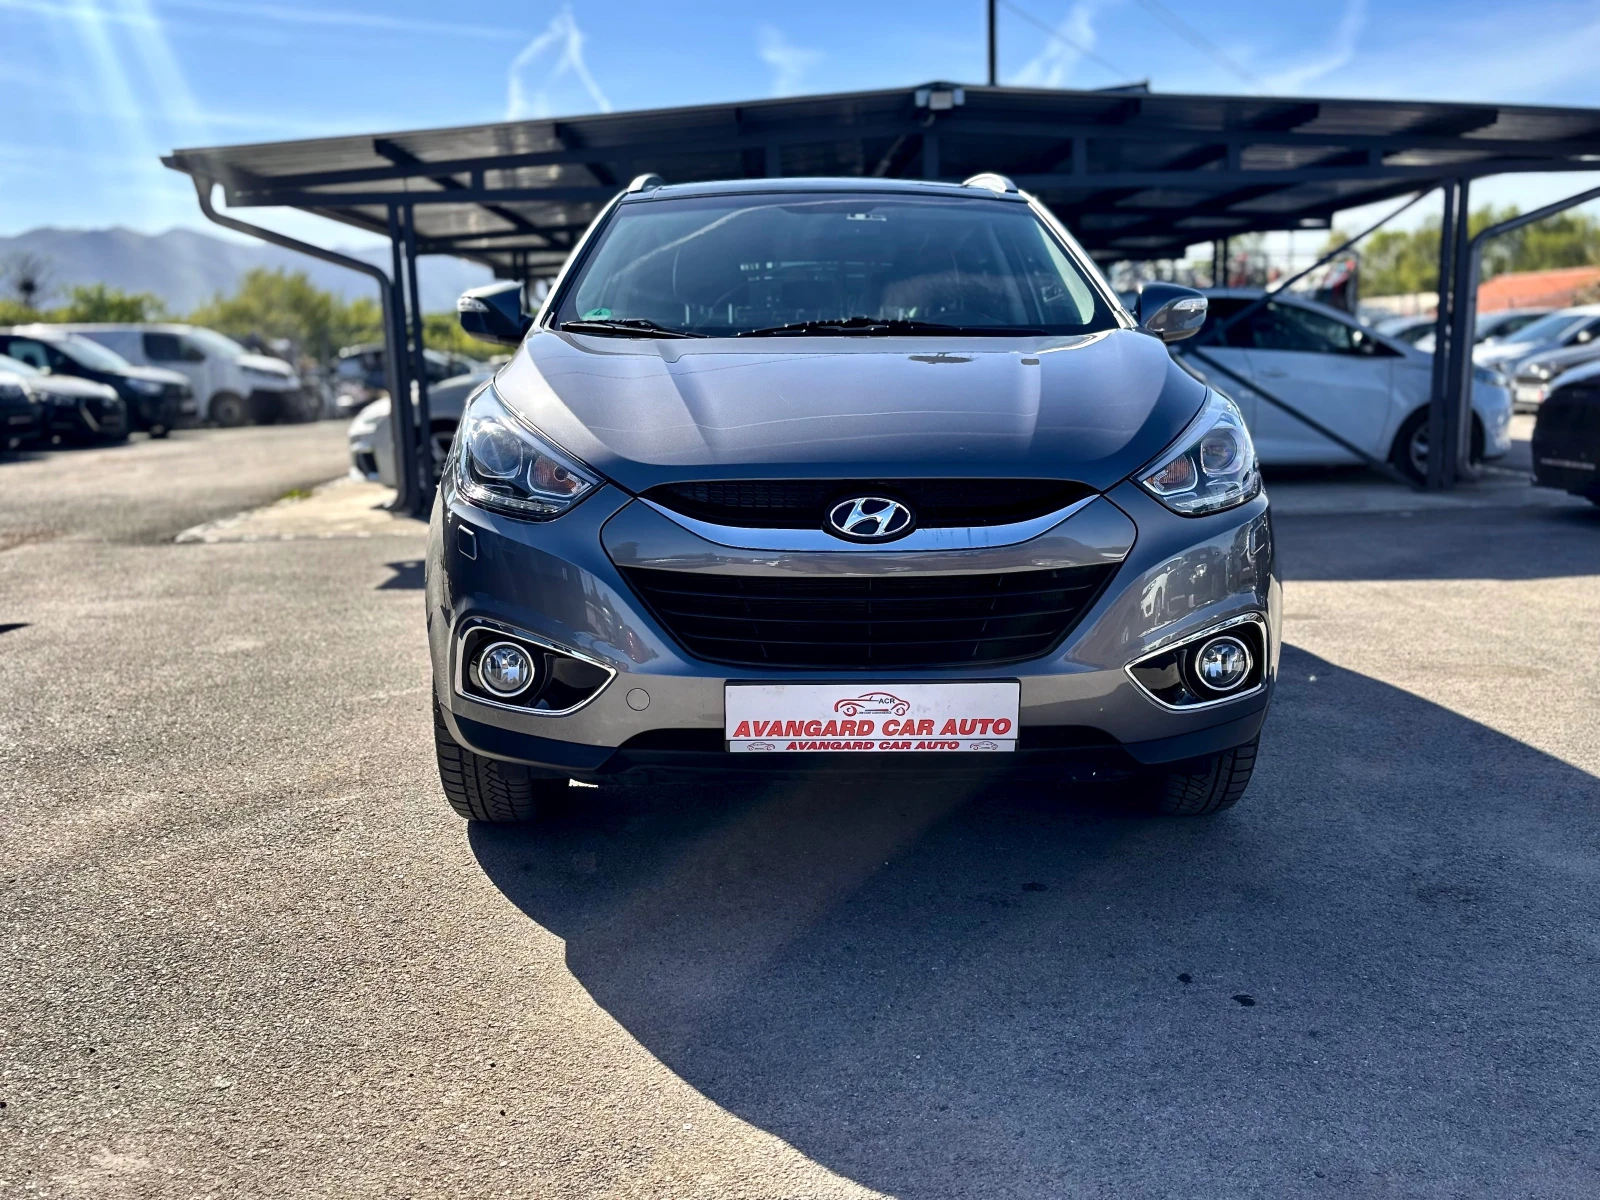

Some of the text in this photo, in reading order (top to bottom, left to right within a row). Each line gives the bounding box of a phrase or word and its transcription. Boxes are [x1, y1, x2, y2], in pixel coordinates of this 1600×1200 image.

[733, 718, 1012, 738] AVANGARD CAR AUTO
[786, 741, 960, 751] AVANGARD CAR AUTO
